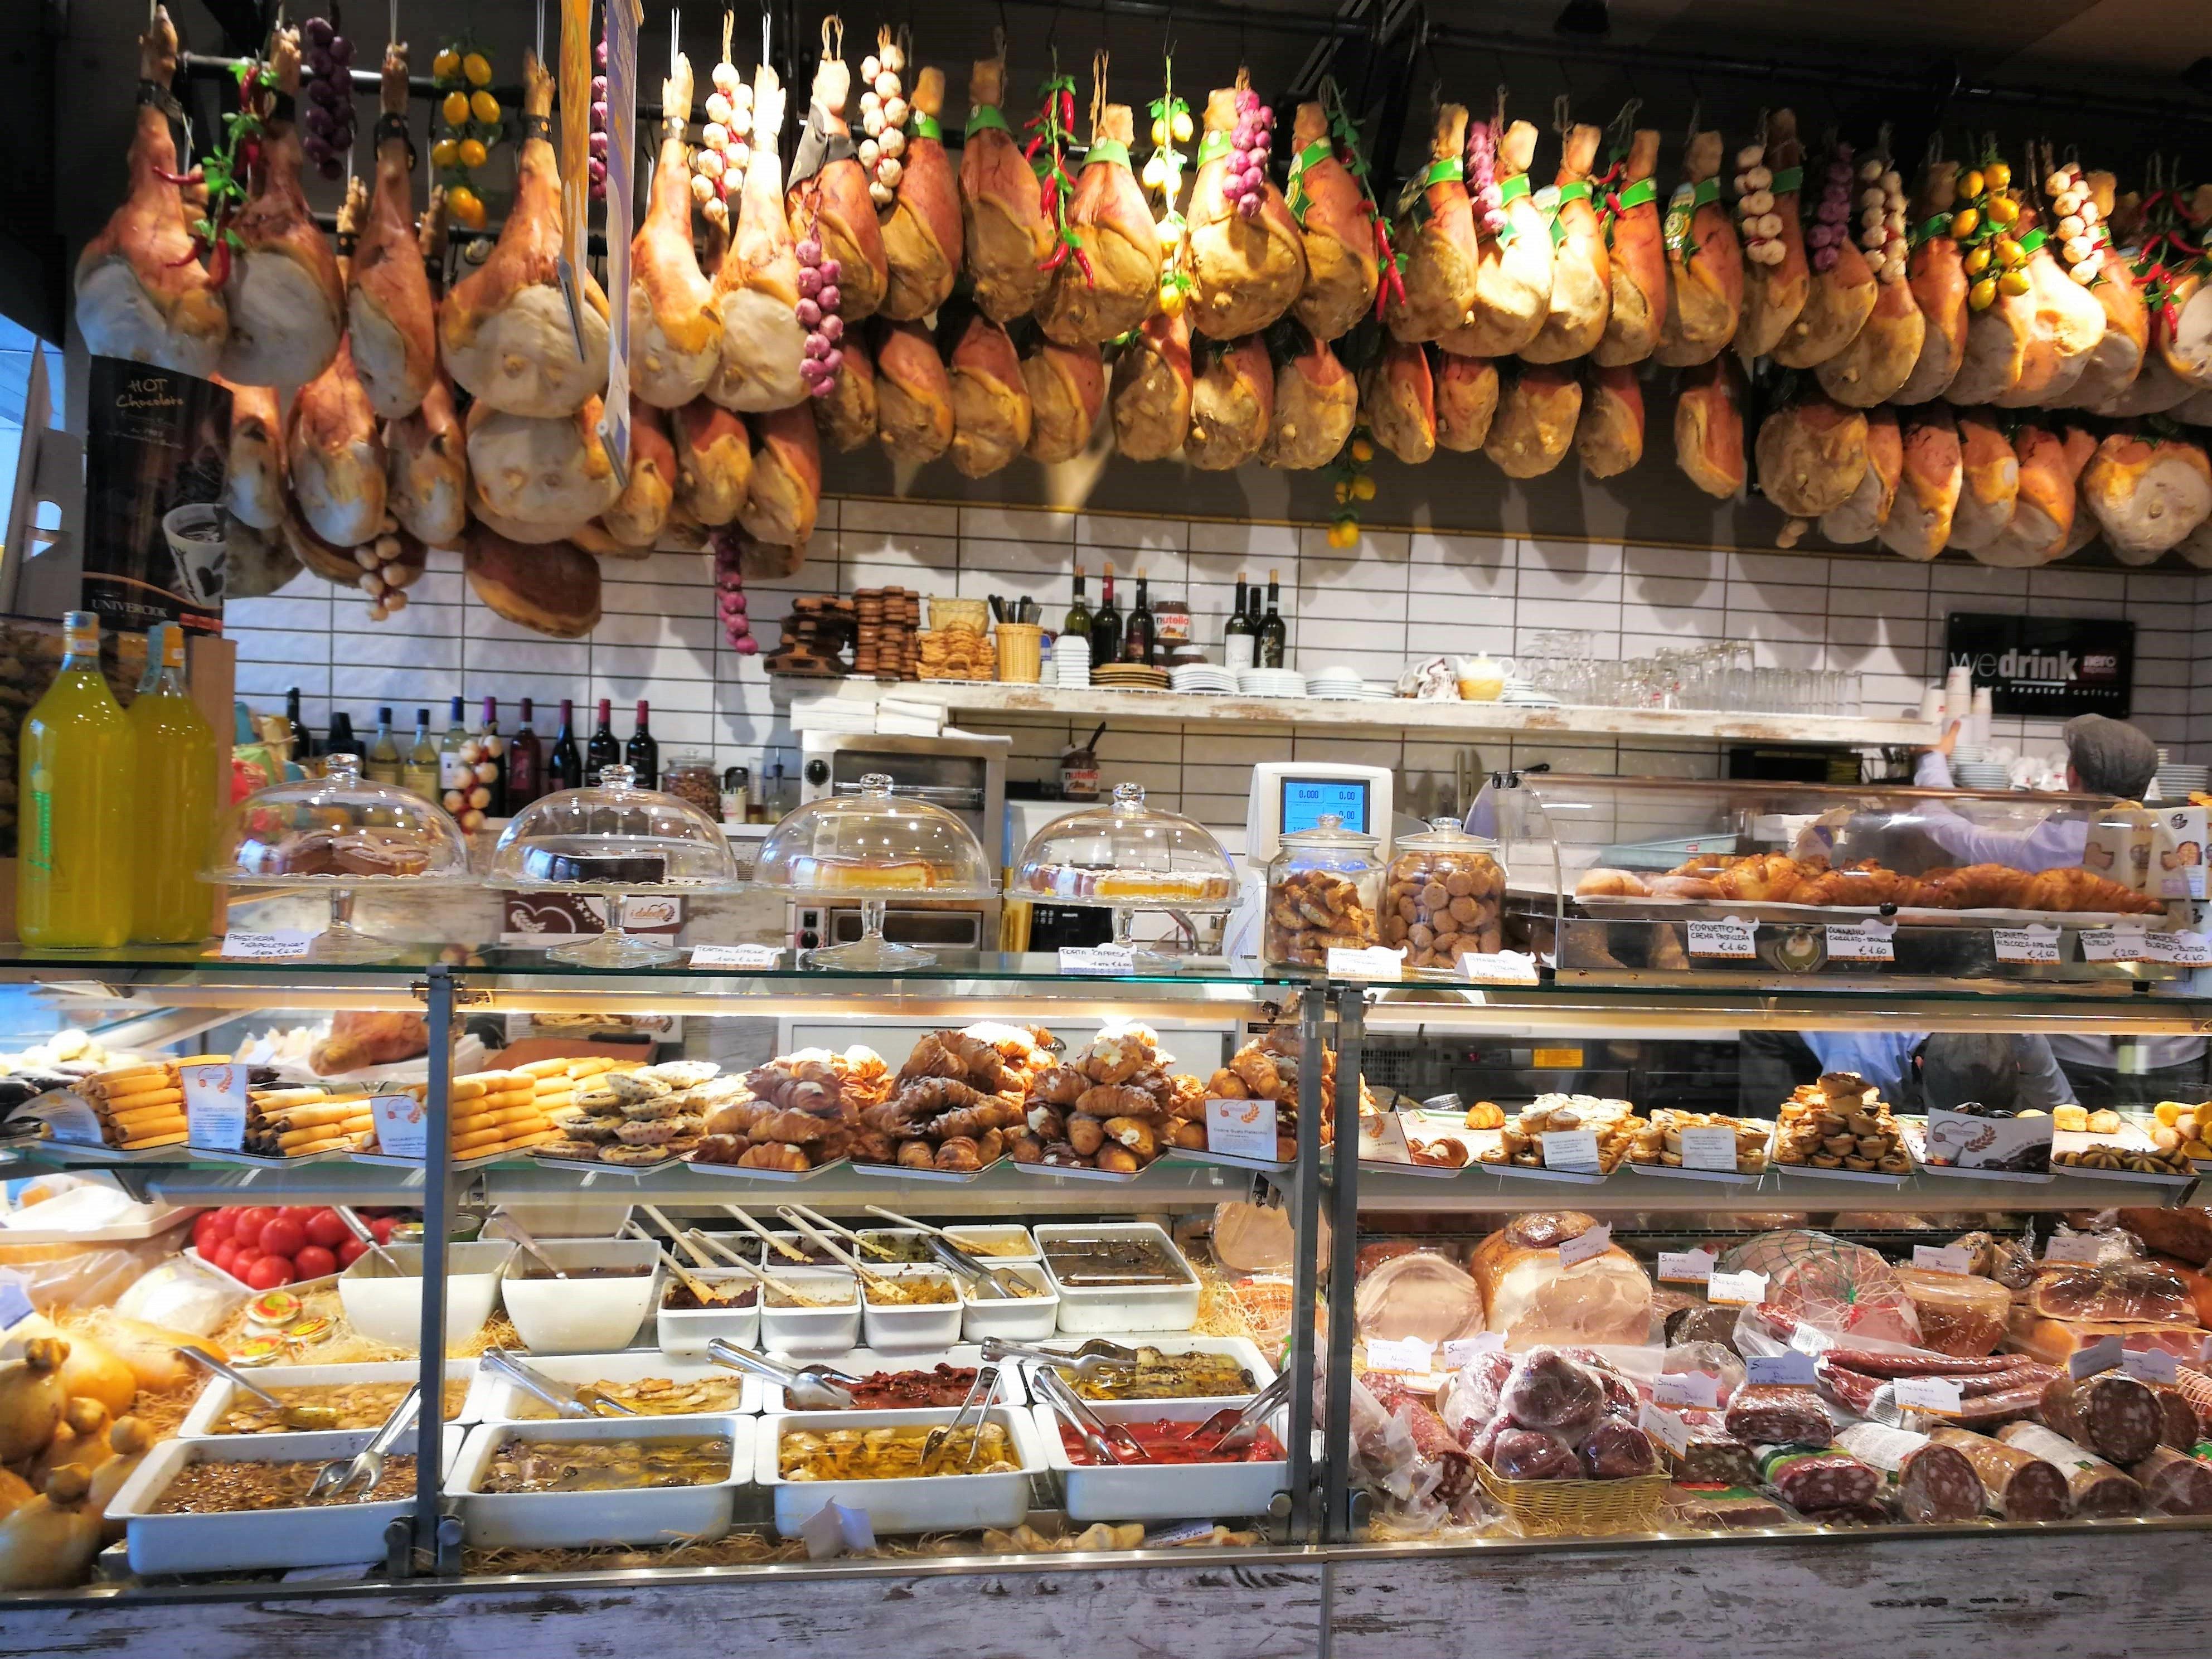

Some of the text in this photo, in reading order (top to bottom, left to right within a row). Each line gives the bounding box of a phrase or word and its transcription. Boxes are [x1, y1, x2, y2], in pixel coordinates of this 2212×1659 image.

[128, 378, 167, 392] HOT
[115, 393, 184, 408] Chocolate
[1156, 615, 1189, 625] nutella
[2011, 686, 2065, 695] roasted
[2073, 688, 2119, 697] coffee
[1065, 770, 1098, 780] nutella
[1299, 789, 1355, 801] 0,000 0,00
[1689, 923, 1734, 933] CORNETTO
